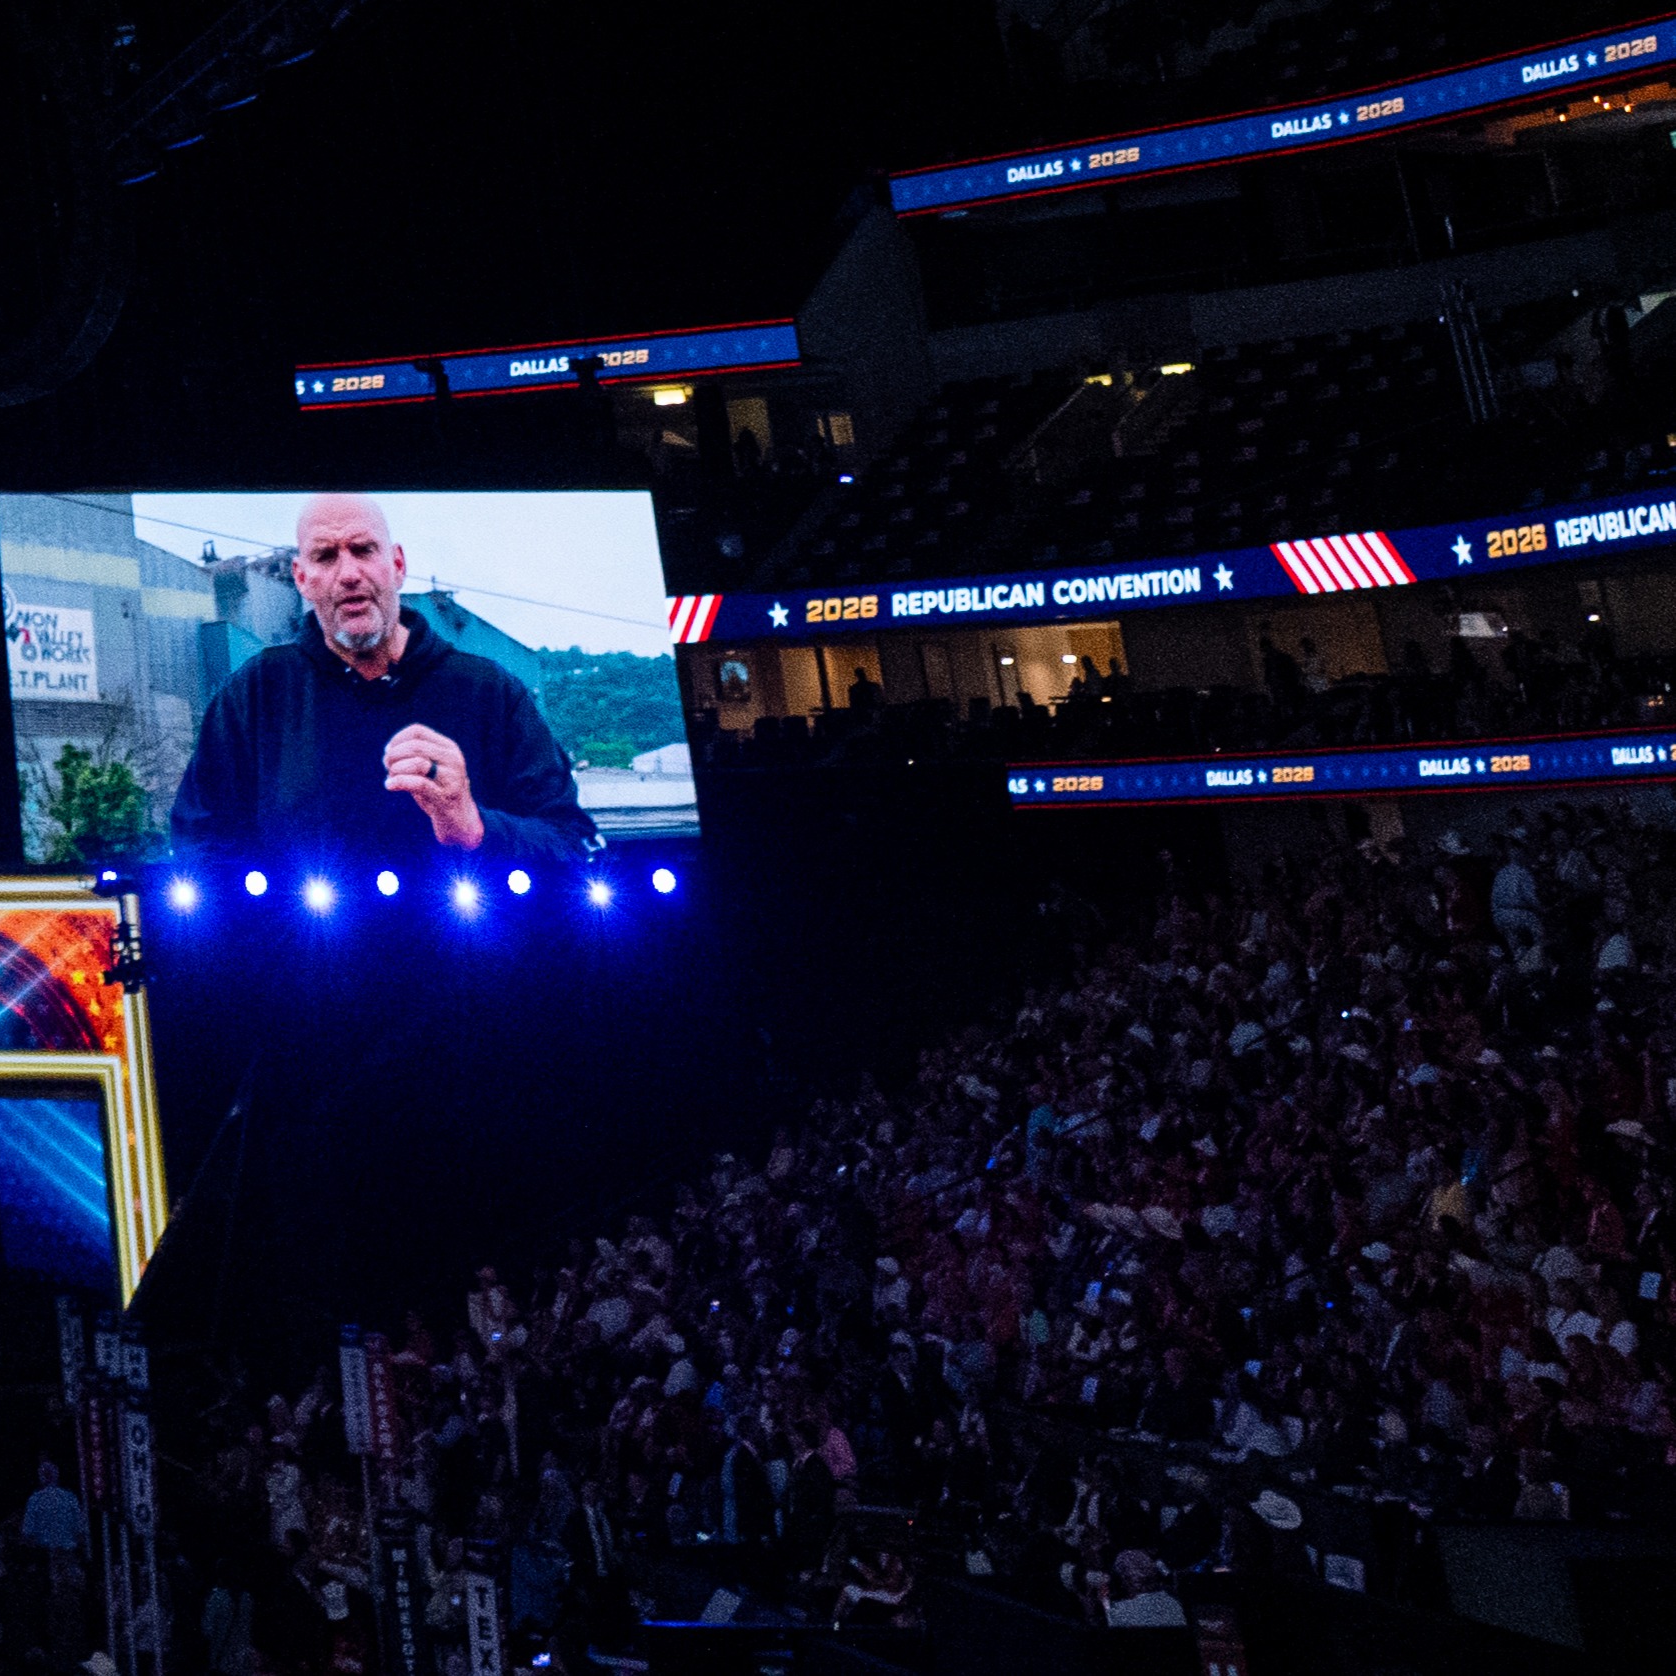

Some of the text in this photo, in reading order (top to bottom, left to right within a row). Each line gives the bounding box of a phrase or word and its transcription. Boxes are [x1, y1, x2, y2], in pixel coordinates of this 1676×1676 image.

[1521, 56, 1580, 83] DALLAS
[1271, 113, 1333, 138] DALLAS
[1007, 159, 1064, 183] DALLAS
[509, 356, 569, 377] DALLAS
[1485, 523, 1548, 559] 2026
[805, 566, 1203, 624] 2026 REPUBLICAN CONVENTION
[1418, 758, 1471, 777] DALLAS
[1611, 746, 1655, 766] DALLAS
[1206, 768, 1253, 787] DALLAS
[131, 1425, 150, 1523] OHIO
